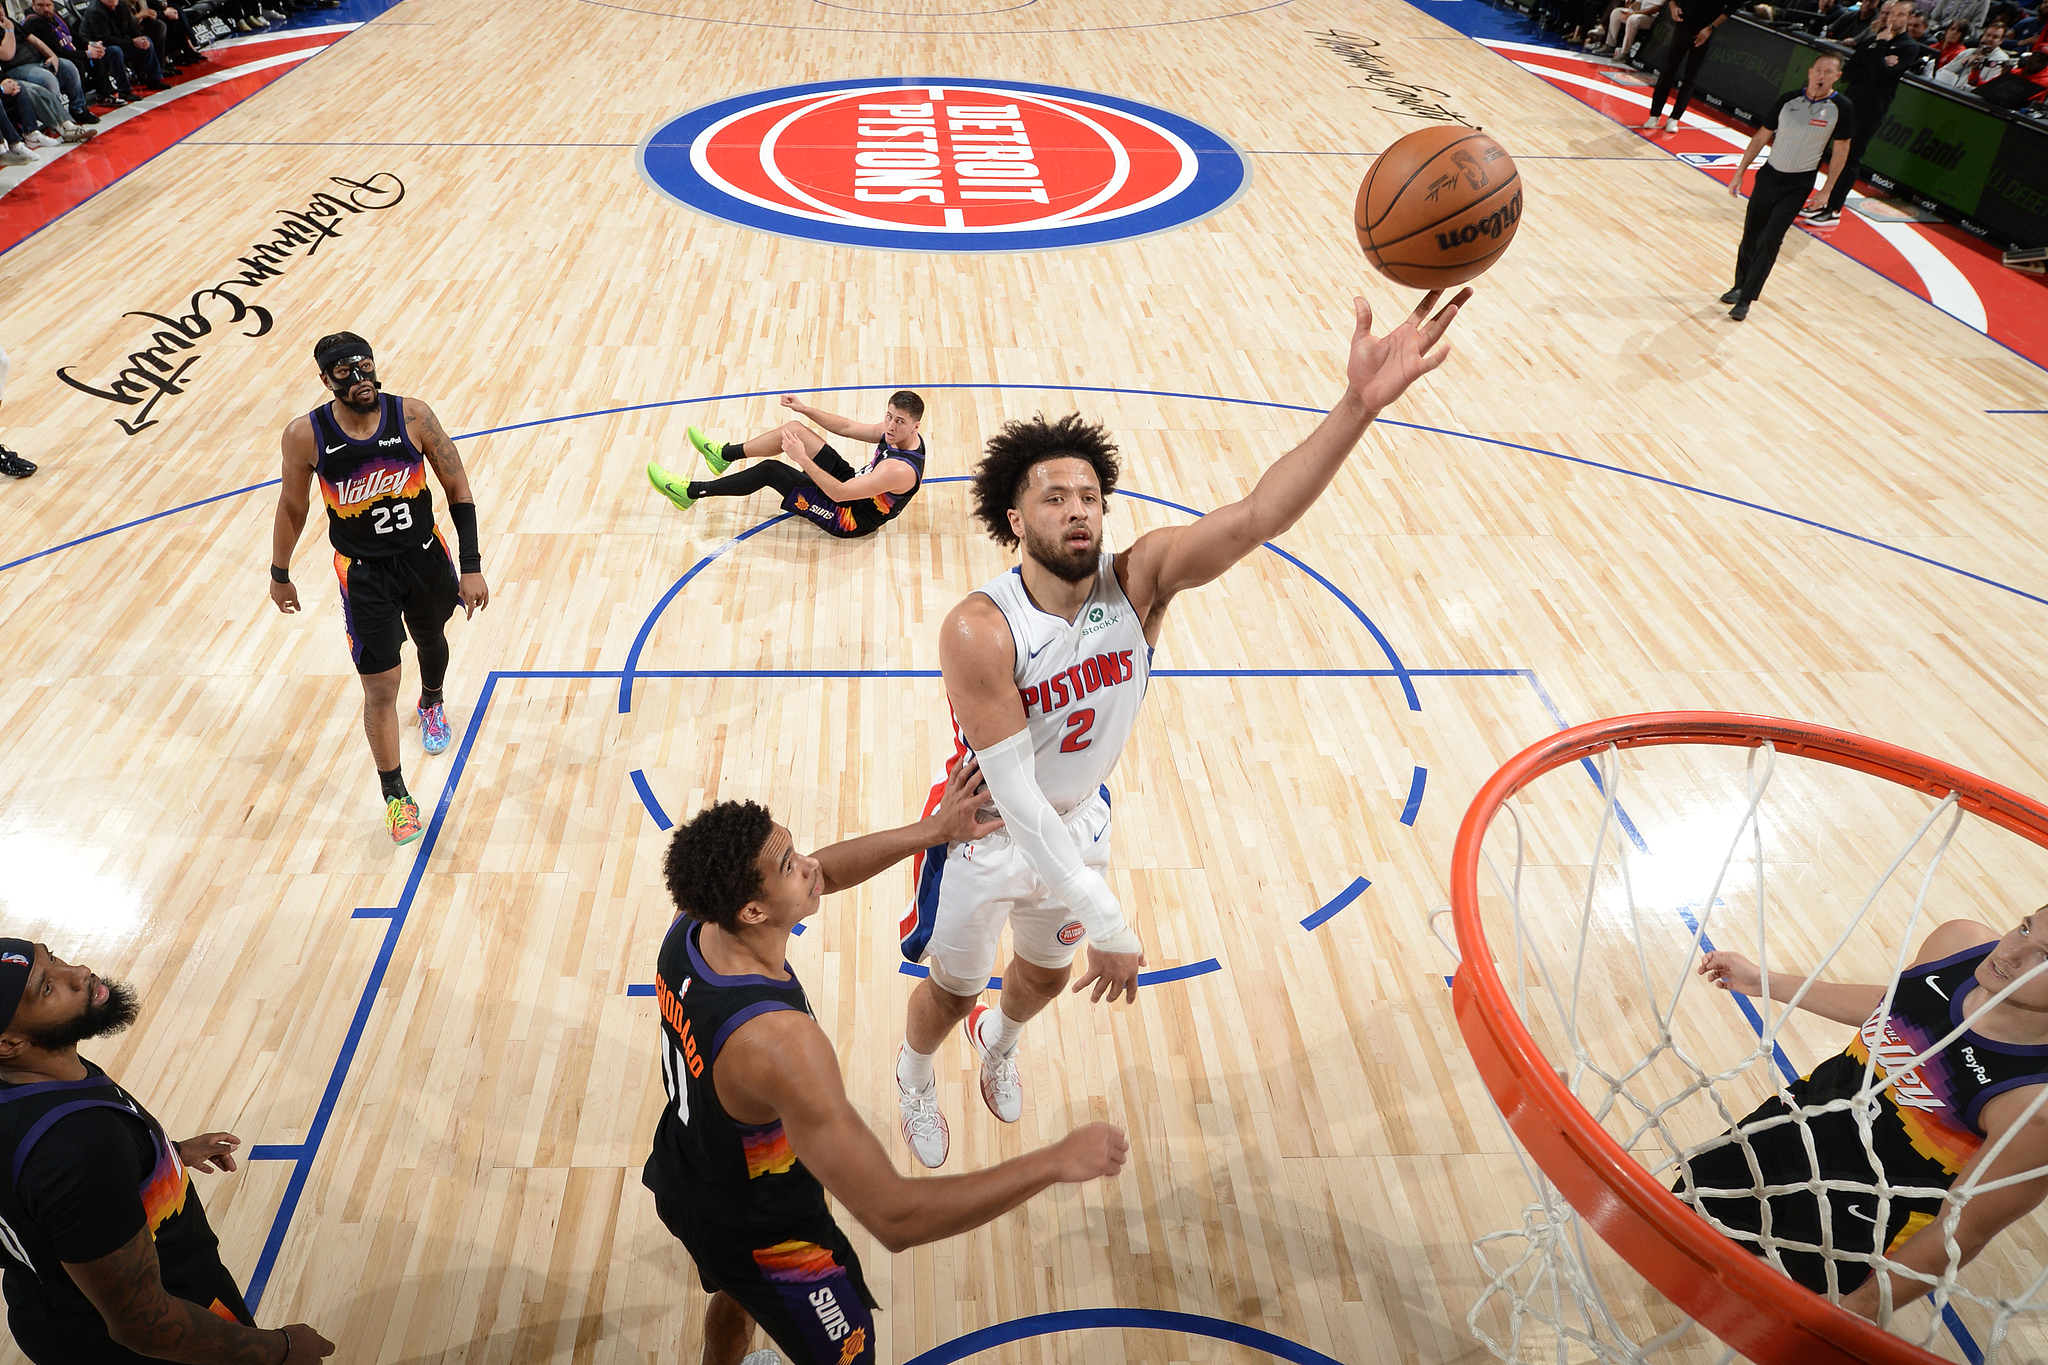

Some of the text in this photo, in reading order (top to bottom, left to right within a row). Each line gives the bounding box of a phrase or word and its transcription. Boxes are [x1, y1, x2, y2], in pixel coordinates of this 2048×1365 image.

[854, 102, 946, 204] PISTONS
[946, 104, 1050, 204] DETROIT
[1908, 127, 1966, 172] Bank
[1871, 173, 1896, 190] StockX
[1435, 188, 1523, 251] Wilson
[56, 172, 405, 435] Platinum Equity
[378, 436, 402, 447] PayPal
[335, 466, 411, 506] Valley
[352, 477, 367, 487] THE
[371, 502, 414, 535] 23
[1082, 615, 1119, 636] StockX
[1019, 649, 1133, 718] PISTONS
[1059, 707, 1096, 753] 2
[1961, 1046, 1992, 1085] PayPal
[808, 1286, 851, 1342] SUNS
